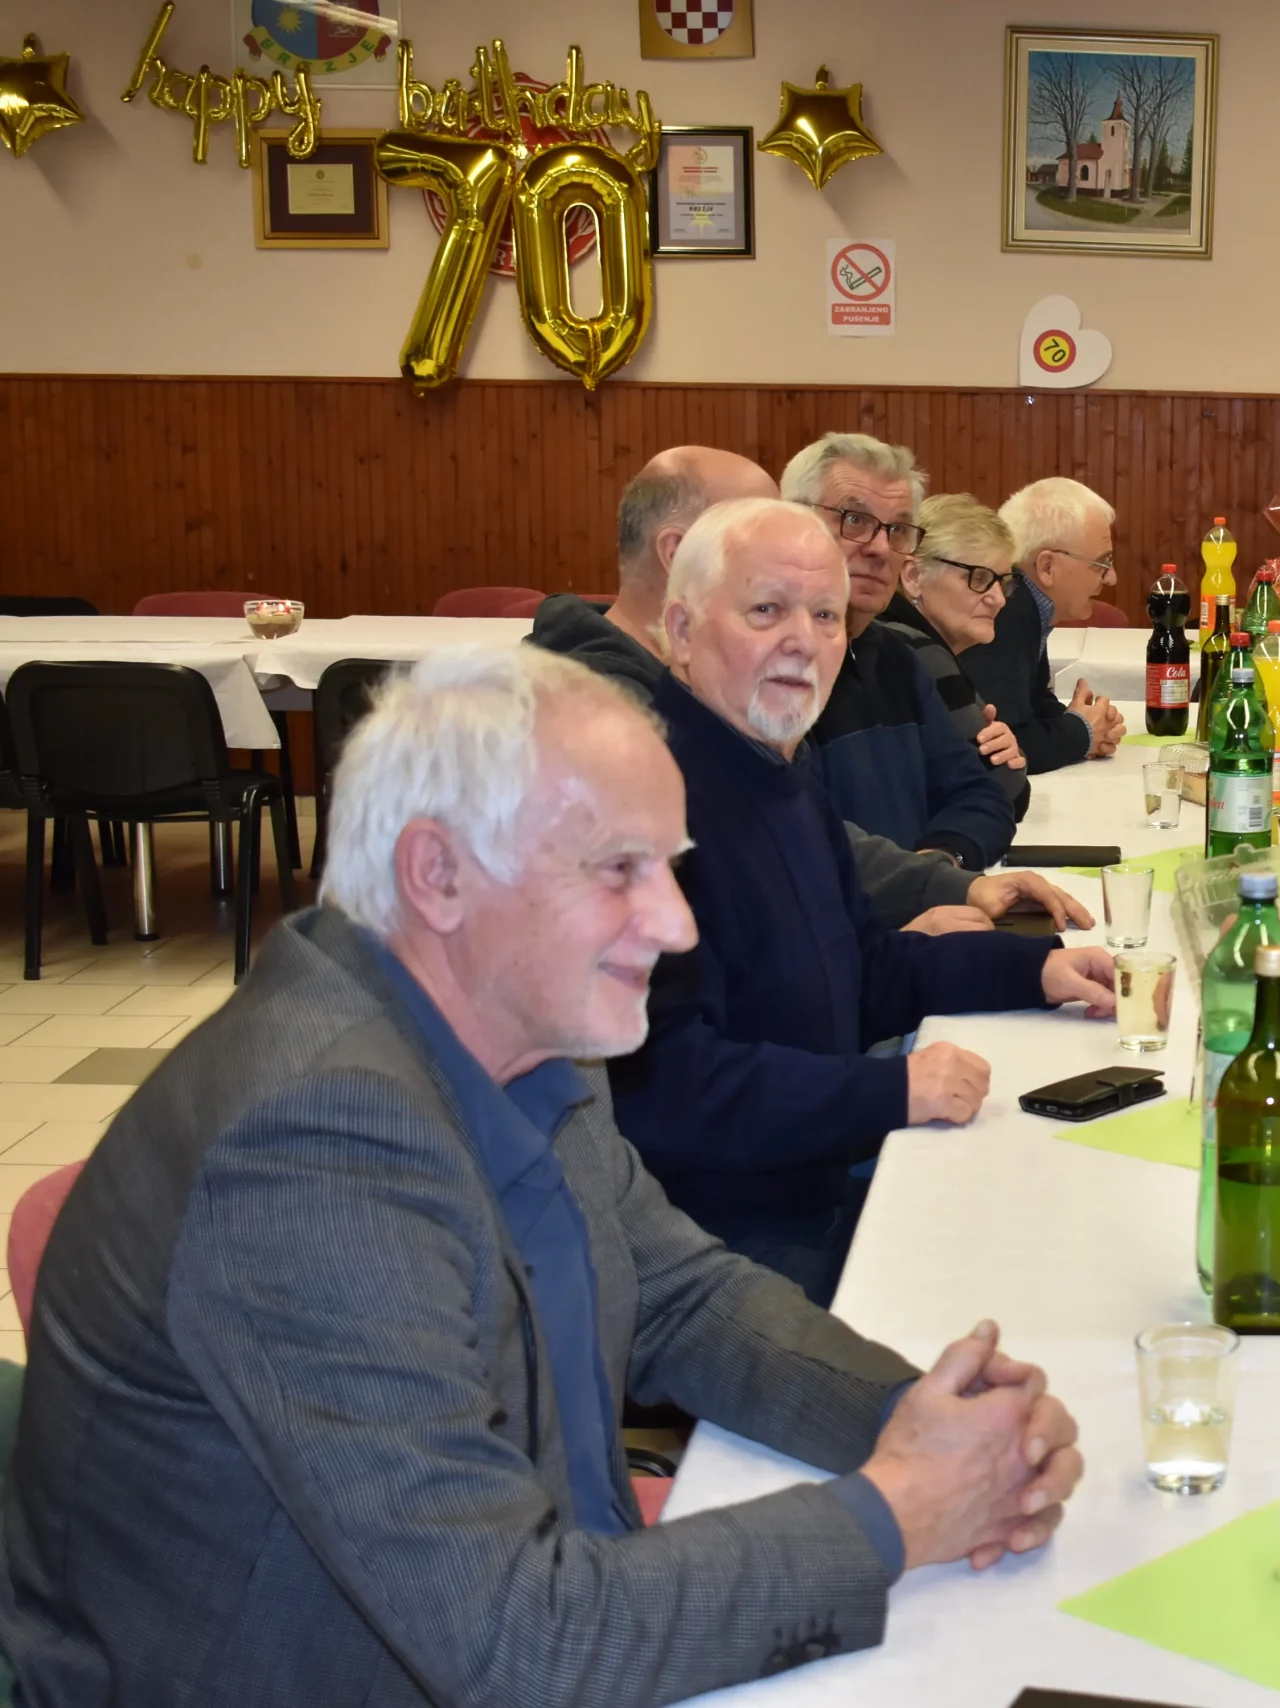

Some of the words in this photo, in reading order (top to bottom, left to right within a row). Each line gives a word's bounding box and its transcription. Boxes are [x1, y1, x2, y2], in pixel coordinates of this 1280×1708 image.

[121, 0, 322, 168] happy
[398, 38, 661, 172] birthday
[375, 129, 654, 395] 70
[834, 306, 889, 314] ZABRANJENO
[1043, 338, 1066, 363] 70
[1166, 666, 1186, 678] Cola
